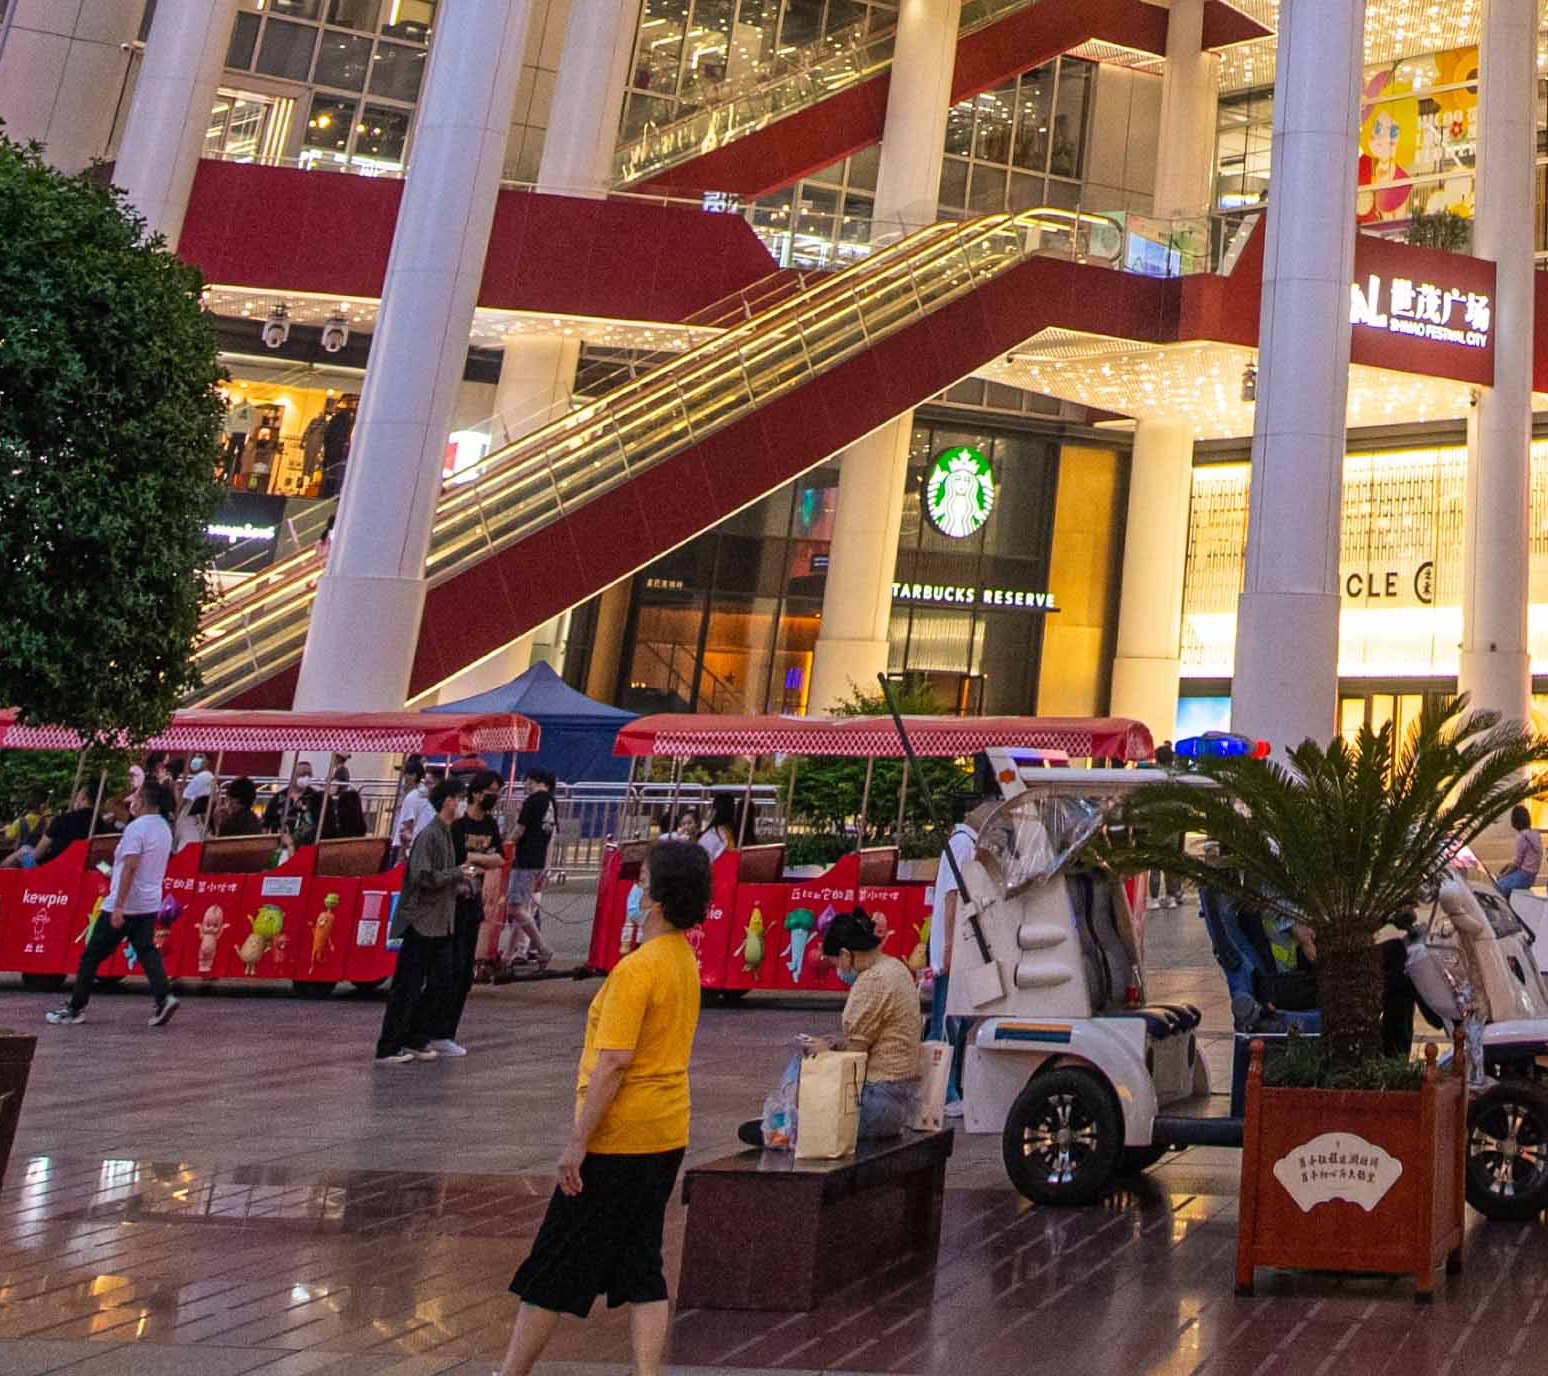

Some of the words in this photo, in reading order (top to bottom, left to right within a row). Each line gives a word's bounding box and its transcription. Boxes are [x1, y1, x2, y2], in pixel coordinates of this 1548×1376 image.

[1390, 277, 1490, 332] 世茂广场
[1390, 318, 1425, 337] SHIMAO
[1425, 324, 1466, 345] FESTIVAL
[1466, 330, 1488, 348] CITY
[892, 582, 975, 603] TARBUCKS
[983, 589, 1055, 609] RESERVE
[1346, 572, 1399, 598] CLE
[22, 888, 69, 909] kewpie
